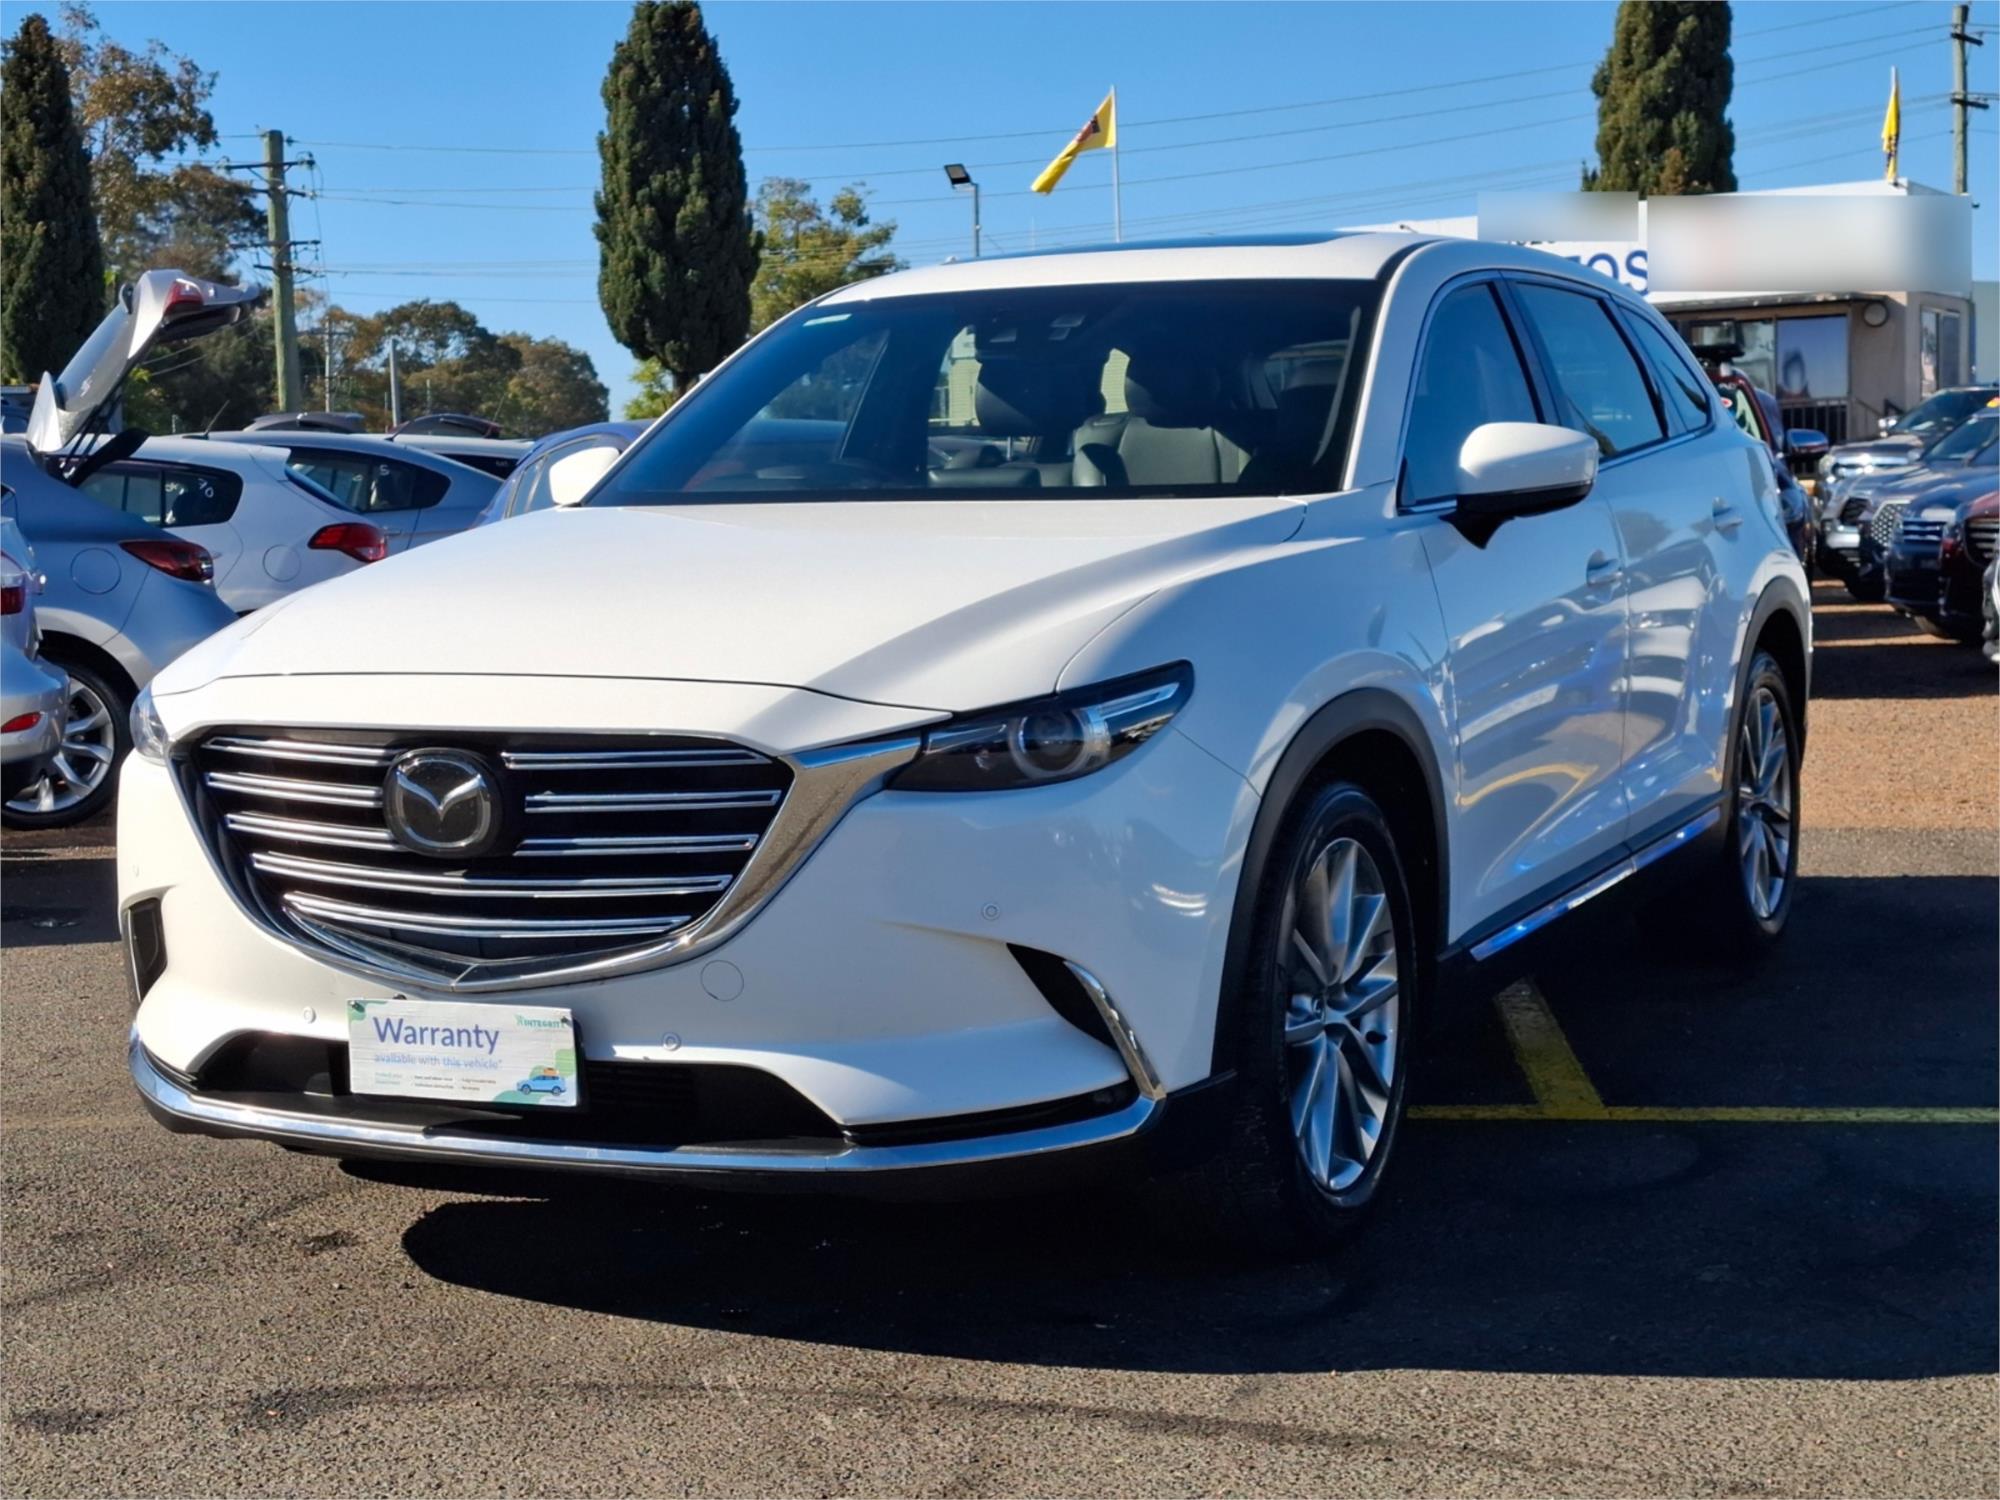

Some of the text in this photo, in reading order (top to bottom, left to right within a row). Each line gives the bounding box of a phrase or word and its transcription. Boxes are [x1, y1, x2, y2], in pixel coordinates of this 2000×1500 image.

[372, 1016, 500, 1055] Warranty
[374, 1053, 416, 1065] available
[418, 1055, 441, 1066] with
[443, 1057, 461, 1067] this
